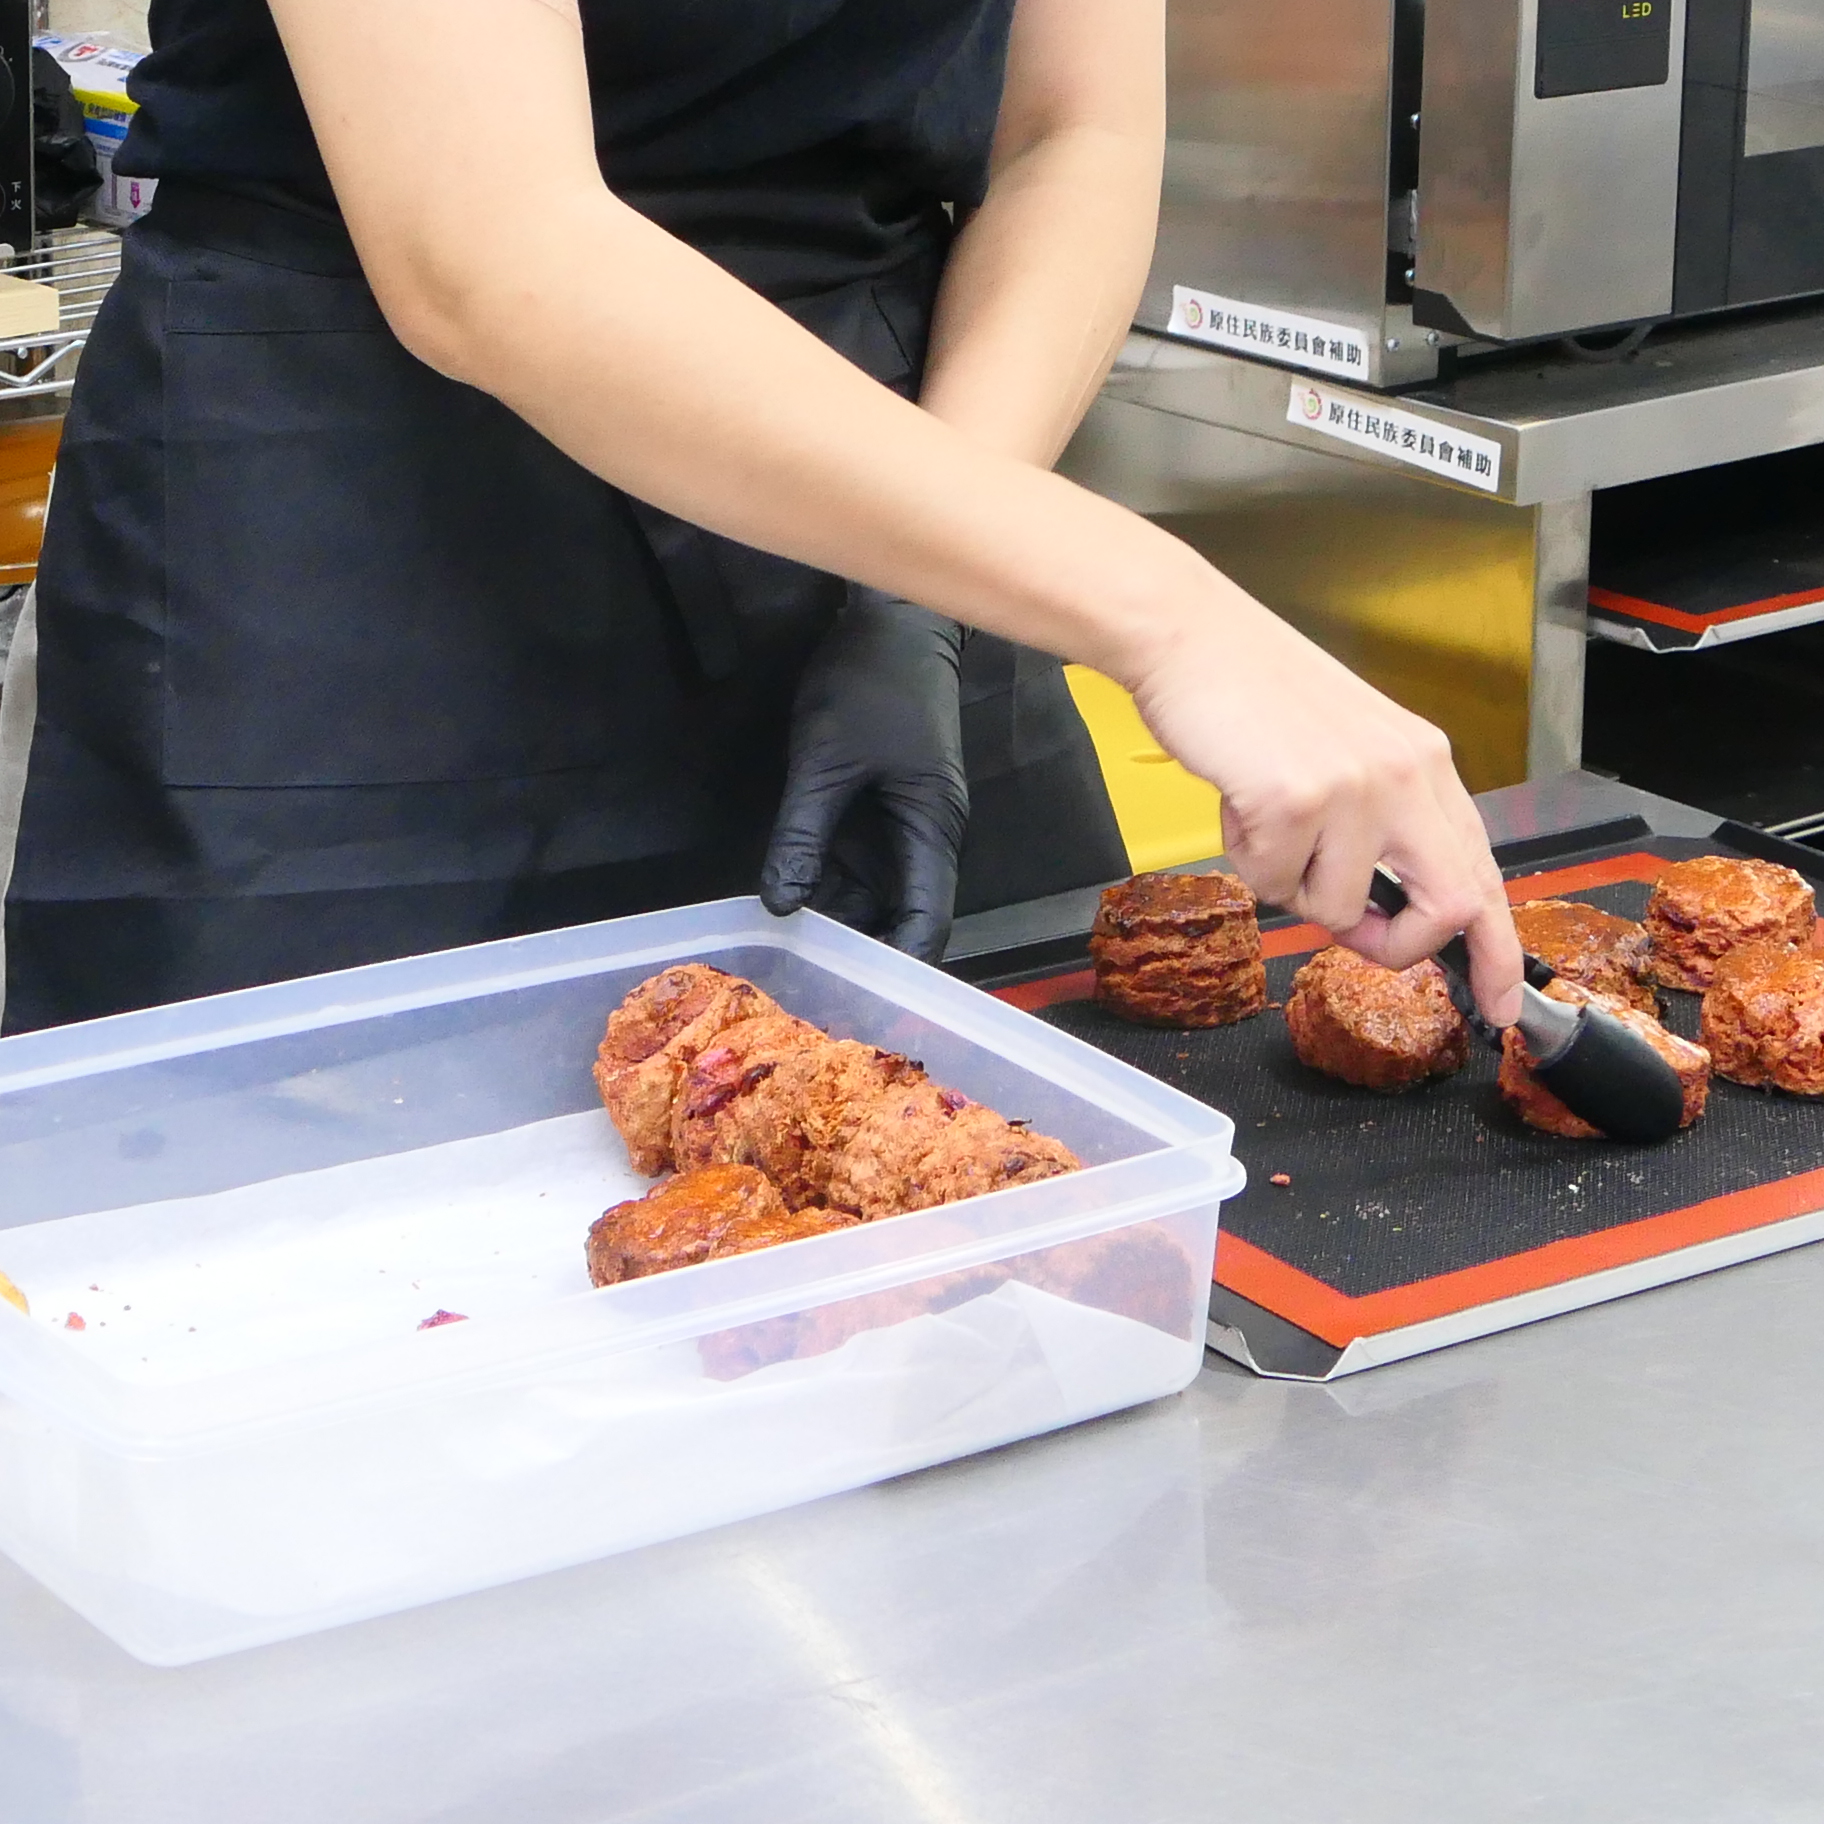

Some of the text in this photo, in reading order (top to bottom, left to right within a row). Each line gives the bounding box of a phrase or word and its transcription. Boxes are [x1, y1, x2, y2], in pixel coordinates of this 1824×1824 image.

[1622, 2, 1652, 19] LED
[1209, 308, 1362, 366] 原住民族委員會補助
[1327, 402, 1492, 477] 原住民族委員會補助
